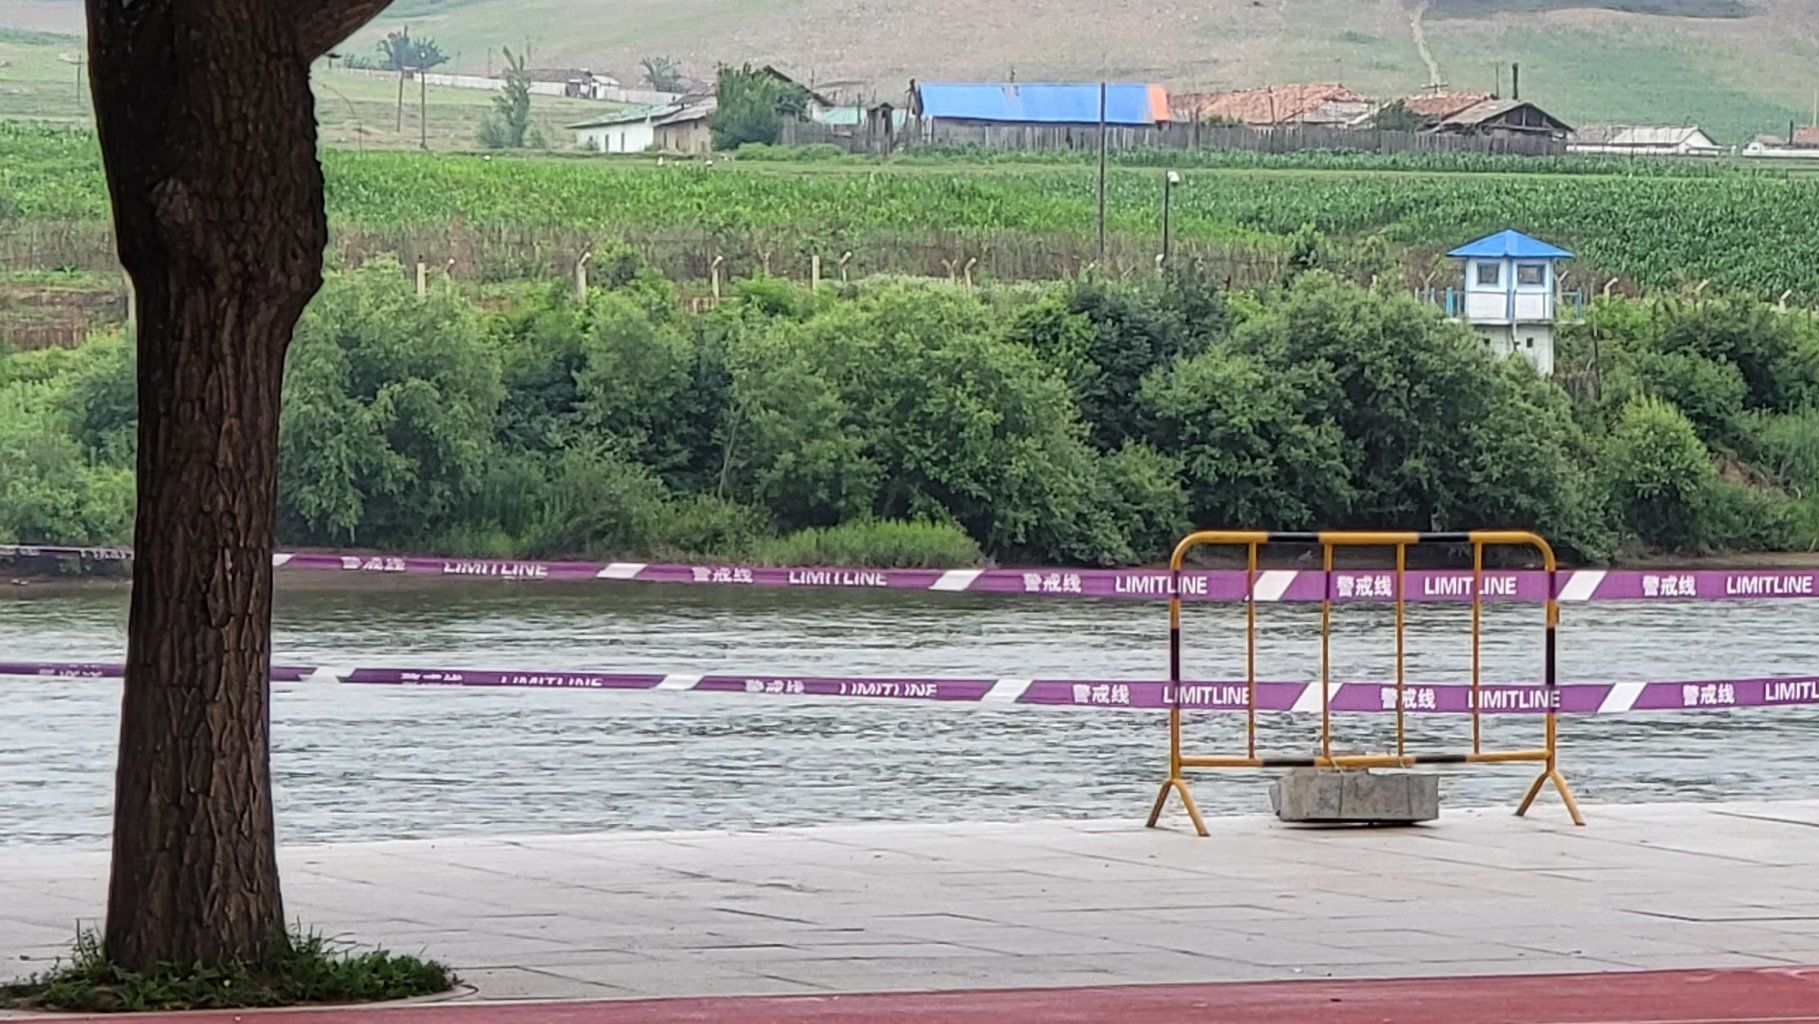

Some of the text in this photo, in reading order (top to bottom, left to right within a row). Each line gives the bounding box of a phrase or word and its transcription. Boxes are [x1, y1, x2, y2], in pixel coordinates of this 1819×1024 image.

[1022, 573, 1208, 595] 警戒线 LIMITLINE
[1336, 574, 1518, 598] 警戒线 LIMITINE
[1642, 575, 1814, 597] 警戒线 LIMITLINE
[1072, 683, 1250, 707] 警戒线 LIMITLINE
[1380, 687, 1437, 710] 警戒线
[1682, 684, 1736, 707] 警戒线
